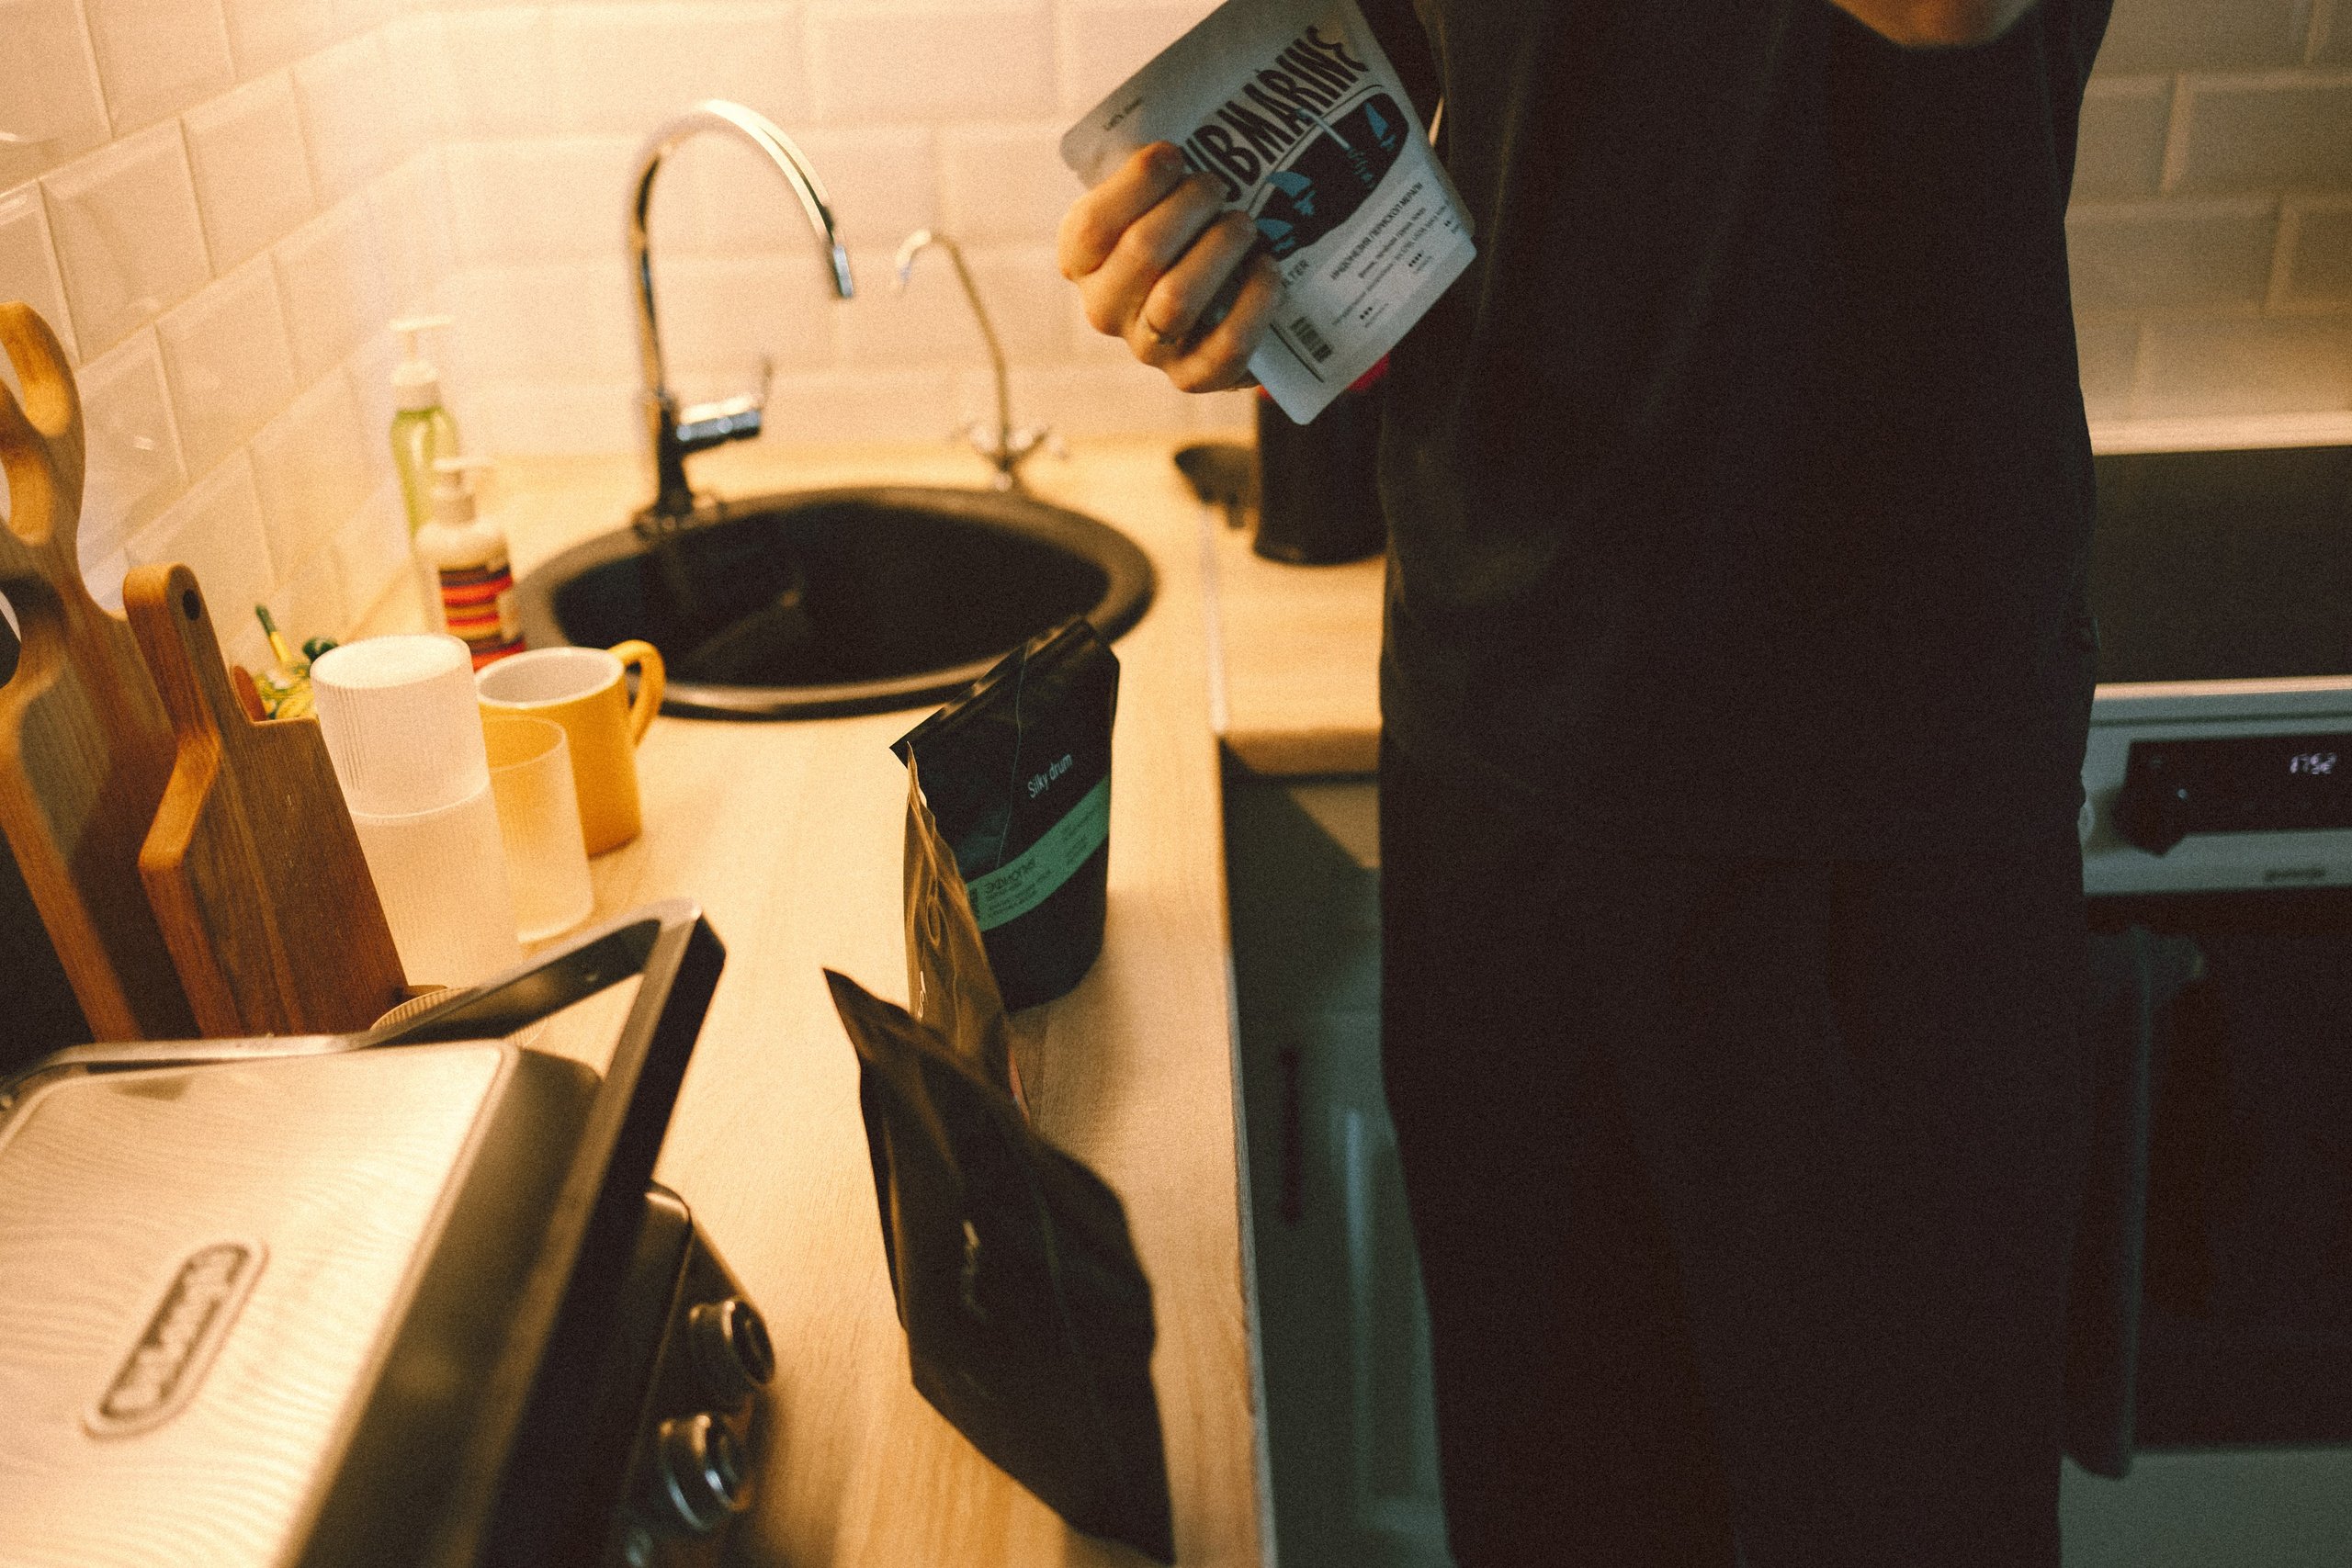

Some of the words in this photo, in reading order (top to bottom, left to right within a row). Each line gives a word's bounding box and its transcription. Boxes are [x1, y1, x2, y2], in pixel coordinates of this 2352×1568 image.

[1180, 24, 1370, 203] UBMARINE
[1027, 773, 1049, 799] Silky
[1048, 753, 1073, 781] drum
